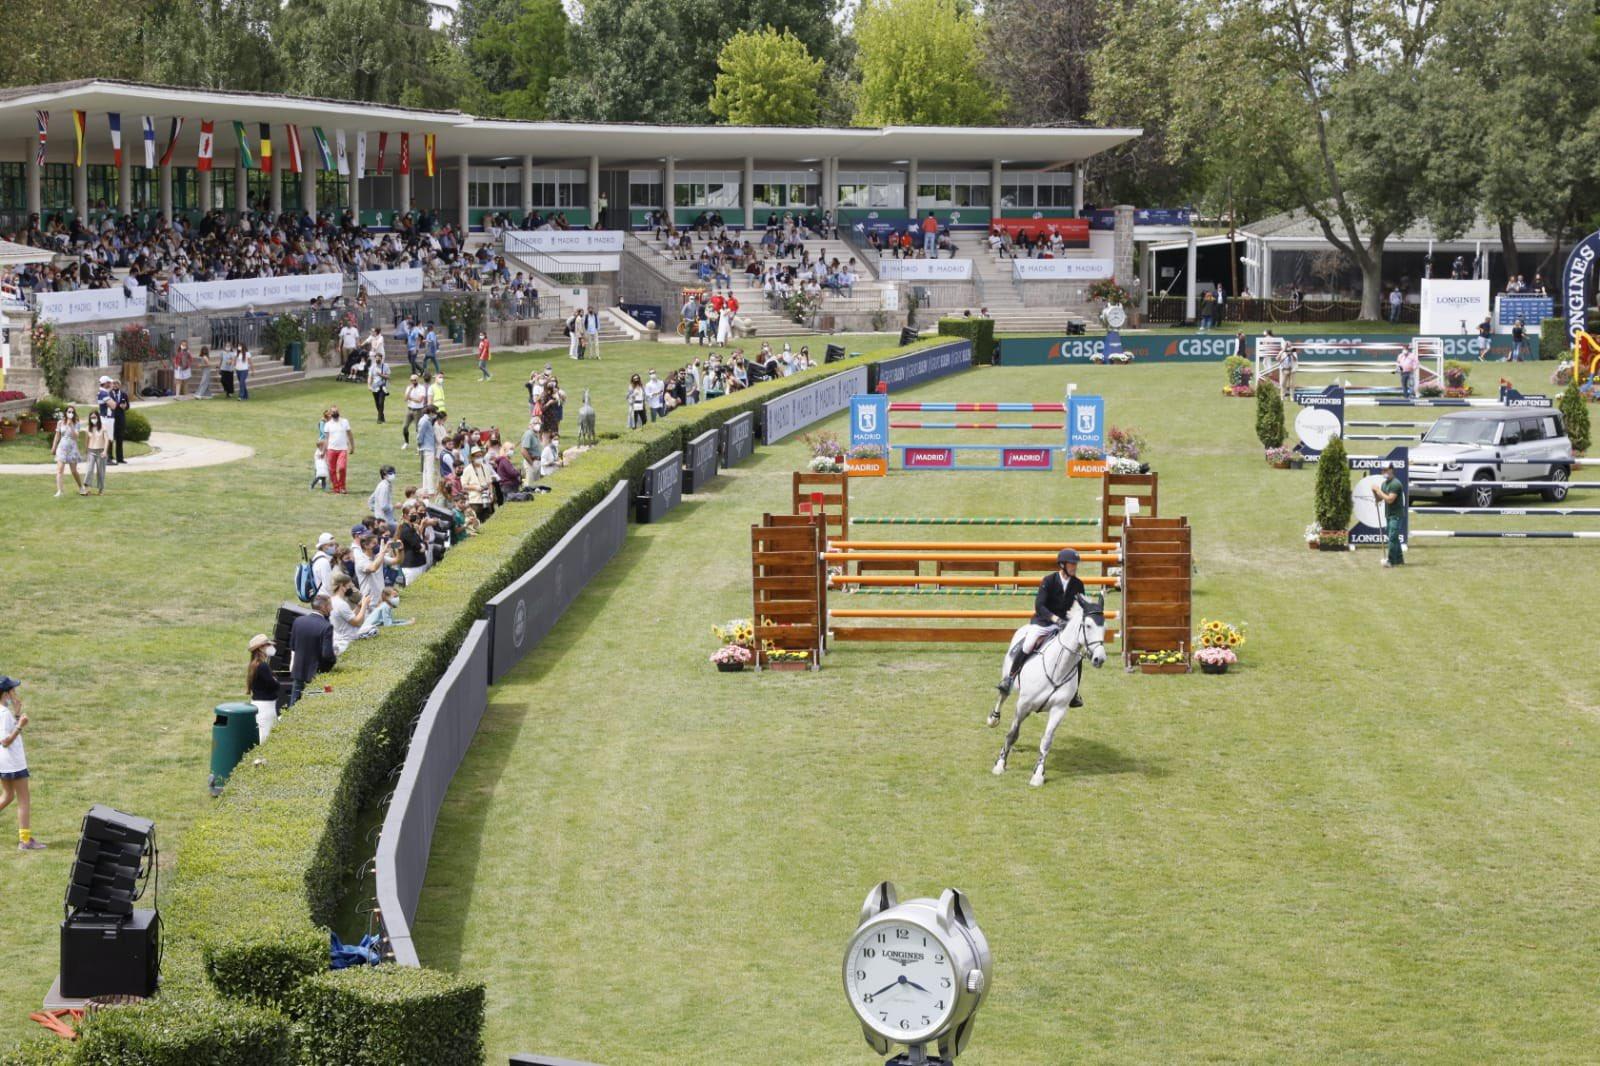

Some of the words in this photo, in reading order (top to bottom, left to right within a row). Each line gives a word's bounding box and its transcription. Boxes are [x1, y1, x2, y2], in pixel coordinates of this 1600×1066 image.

[937, 265, 965, 273] MADRID
[1028, 265, 1055, 273] MADRID
[1075, 265, 1103, 273] MADRID
[1062, 340, 1105, 358] case
[1179, 338, 1237, 356] caser
[1443, 338, 1483, 355] ase
[1509, 399, 1550, 407] LONGINES
[854, 433, 881, 441] MADRID
[1072, 434, 1099, 442] MADRID
[912, 450, 949, 465] ¡MADRID!
[1008, 450, 1045, 465] ¡MADRID!
[849, 463, 880, 472] MADRID
[1072, 464, 1106, 473] MADRID
[1351, 534, 1405, 543] LONGINS
[877, 933, 886, 944] 11
[896, 929, 909, 940] 12
[923, 937, 927, 947] 1
[863, 947, 876, 958] 10
[882, 949, 925, 961] LONGINES
[934, 953, 945, 964] 2
[856, 969, 866, 981] 9
[940, 976, 951, 989] 3
[863, 993, 874, 1004] 8
[934, 1000, 945, 1011] 4
[879, 1011, 889, 1022] 7
[921, 1015, 930, 1026] 5
[900, 1018, 910, 1030] 6
